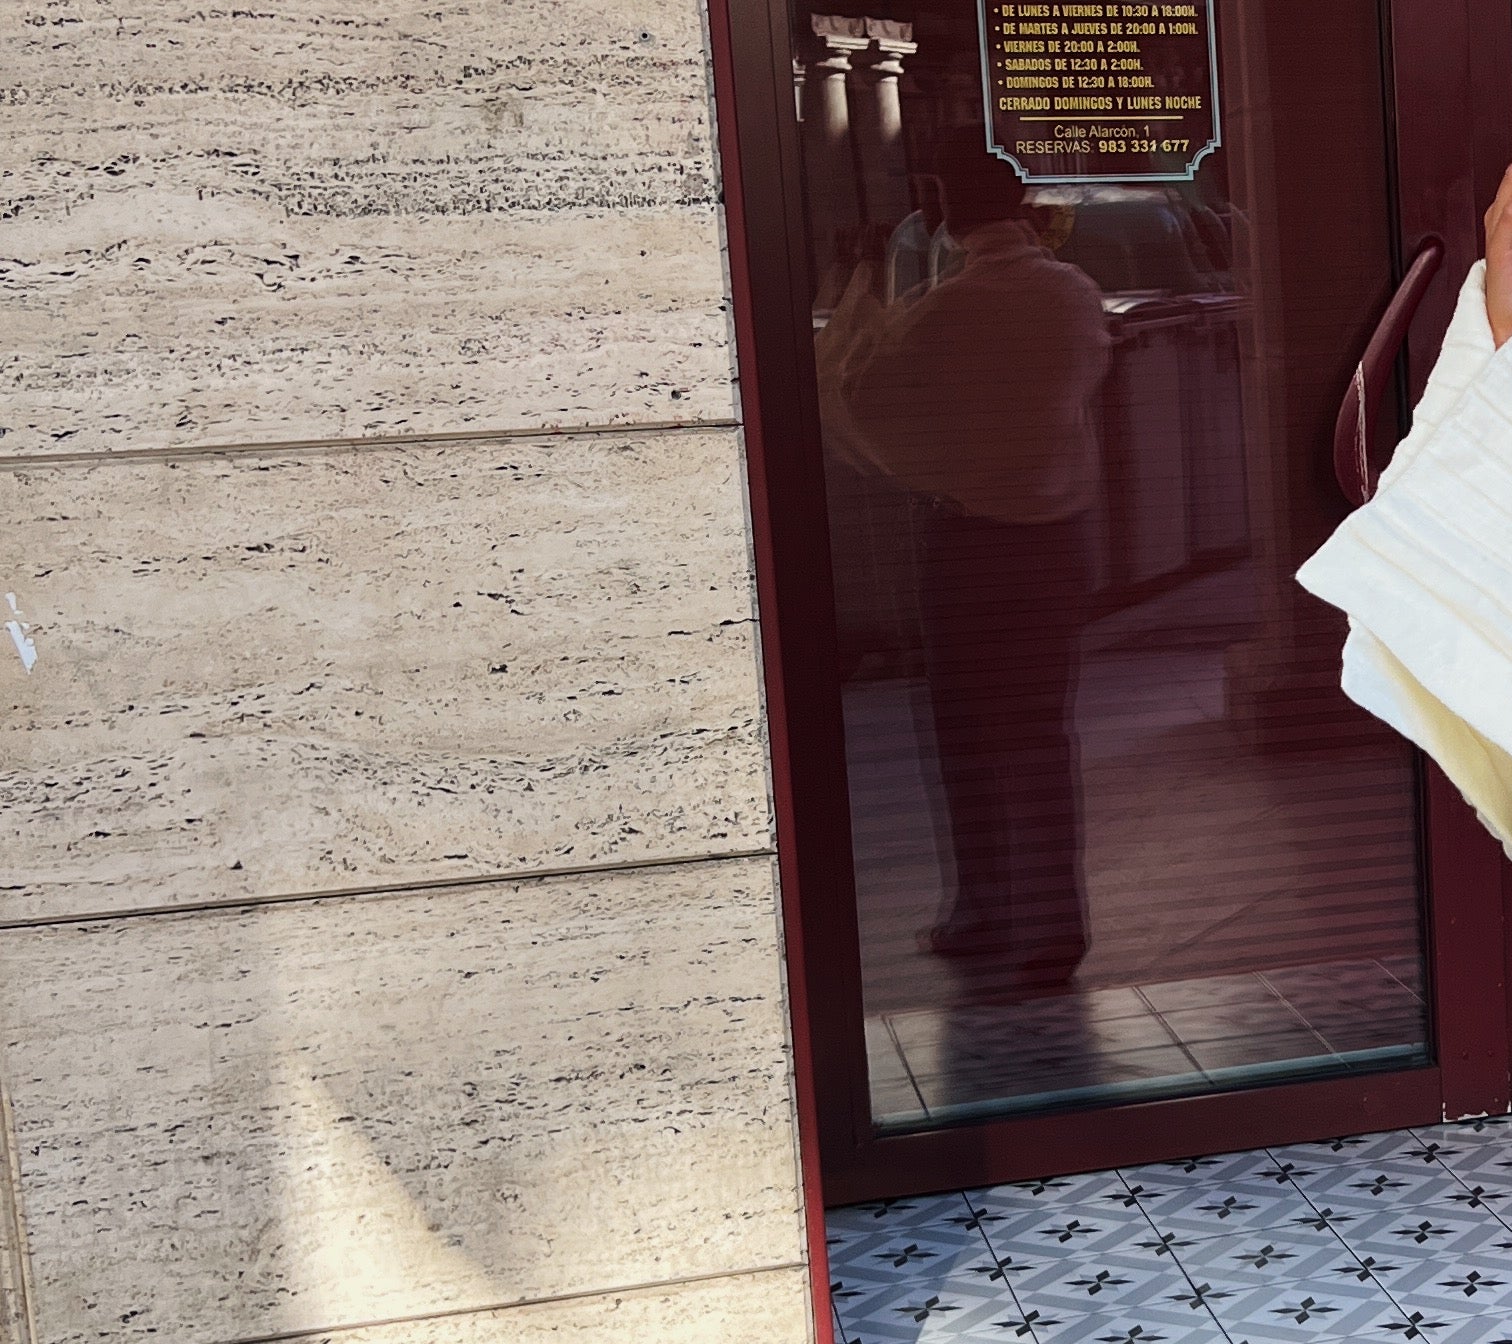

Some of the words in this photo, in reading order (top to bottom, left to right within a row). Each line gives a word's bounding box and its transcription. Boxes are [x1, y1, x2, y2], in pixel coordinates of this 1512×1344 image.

[1002, 5, 1015, 17] DE
[1018, 5, 1050, 17] LUNES
[1052, 5, 1060, 17] A
[1062, 5, 1103, 17] VIERNES
[1106, 5, 1119, 17] DE
[1122, 5, 1148, 17] 10:30
[1151, 5, 1159, 17] A
[1003, 22, 1016, 35] DE
[1019, 22, 1058, 35] MARTES
[1061, 22, 1069, 35] A
[1071, 22, 1108, 35] JUEVES
[1110, 22, 1123, 35] DE
[1126, 22, 1156, 35] 20:00
[1158, 22, 1166, 35] A
[1003, 41, 1045, 53] VIERNES
[1048, 41, 1060, 53] DE
[1064, 41, 1094, 53] 20:00
[1097, 41, 1104, 53] A
[1005, 59, 1051, 71] SABADOS
[1055, 59, 1067, 71] DE
[1070, 59, 1097, 71] 12:30
[1100, 59, 1108, 71] A
[1006, 77, 1059, 89] DOMINGOS
[1062, 77, 1075, 89] DE
[1078, 77, 1104, 89] 12:30
[1107, 77, 1115, 89] A
[1000, 96, 1051, 110] CERRADO
[1054, 96, 1112, 110] DOMINGOS
[1116, 96, 1124, 110] Y
[1127, 96, 1161, 110] LUNES
[1165, 96, 1201, 110] NOCHE
[1054, 125, 1086, 138] Calle
[1143, 125, 1150, 138] 1
[1016, 140, 1094, 154] RESERVAS:
[1099, 140, 1126, 153] 983
[1161, 139, 1190, 152] 677
